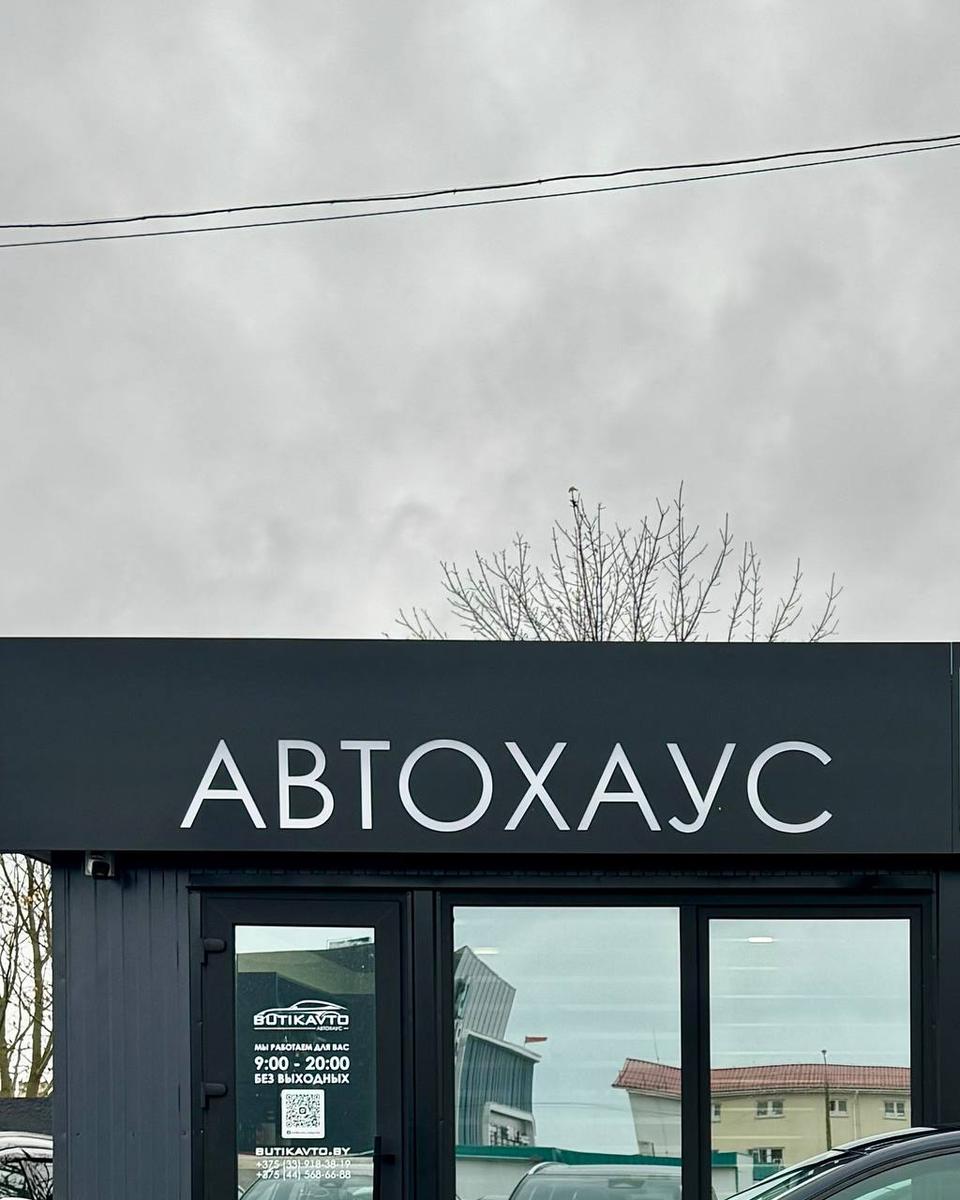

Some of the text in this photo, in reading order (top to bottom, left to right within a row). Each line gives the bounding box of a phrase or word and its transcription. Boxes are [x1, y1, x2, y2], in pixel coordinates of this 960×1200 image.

[180, 739, 833, 834] АВТОХАУС
[253, 1014, 350, 1026] BUTIKAVTO
[254, 1043, 350, 1052] МЫ РАБОТАЕМ ДЛЯ ВАС
[254, 1055, 289, 1071] 9:00
[305, 1055, 350, 1071] 20:00
[254, 1073, 350, 1085] БЕЗ ВЫХОДНЫХ
[255, 1147, 351, 1156] BUTIKAVTO.BY
[256, 1159, 351, 1170] +375 (33) 918-38-19
[282, 1169, 301, 1181] (44)
[303, 1169, 352, 1180] 568-66-88
